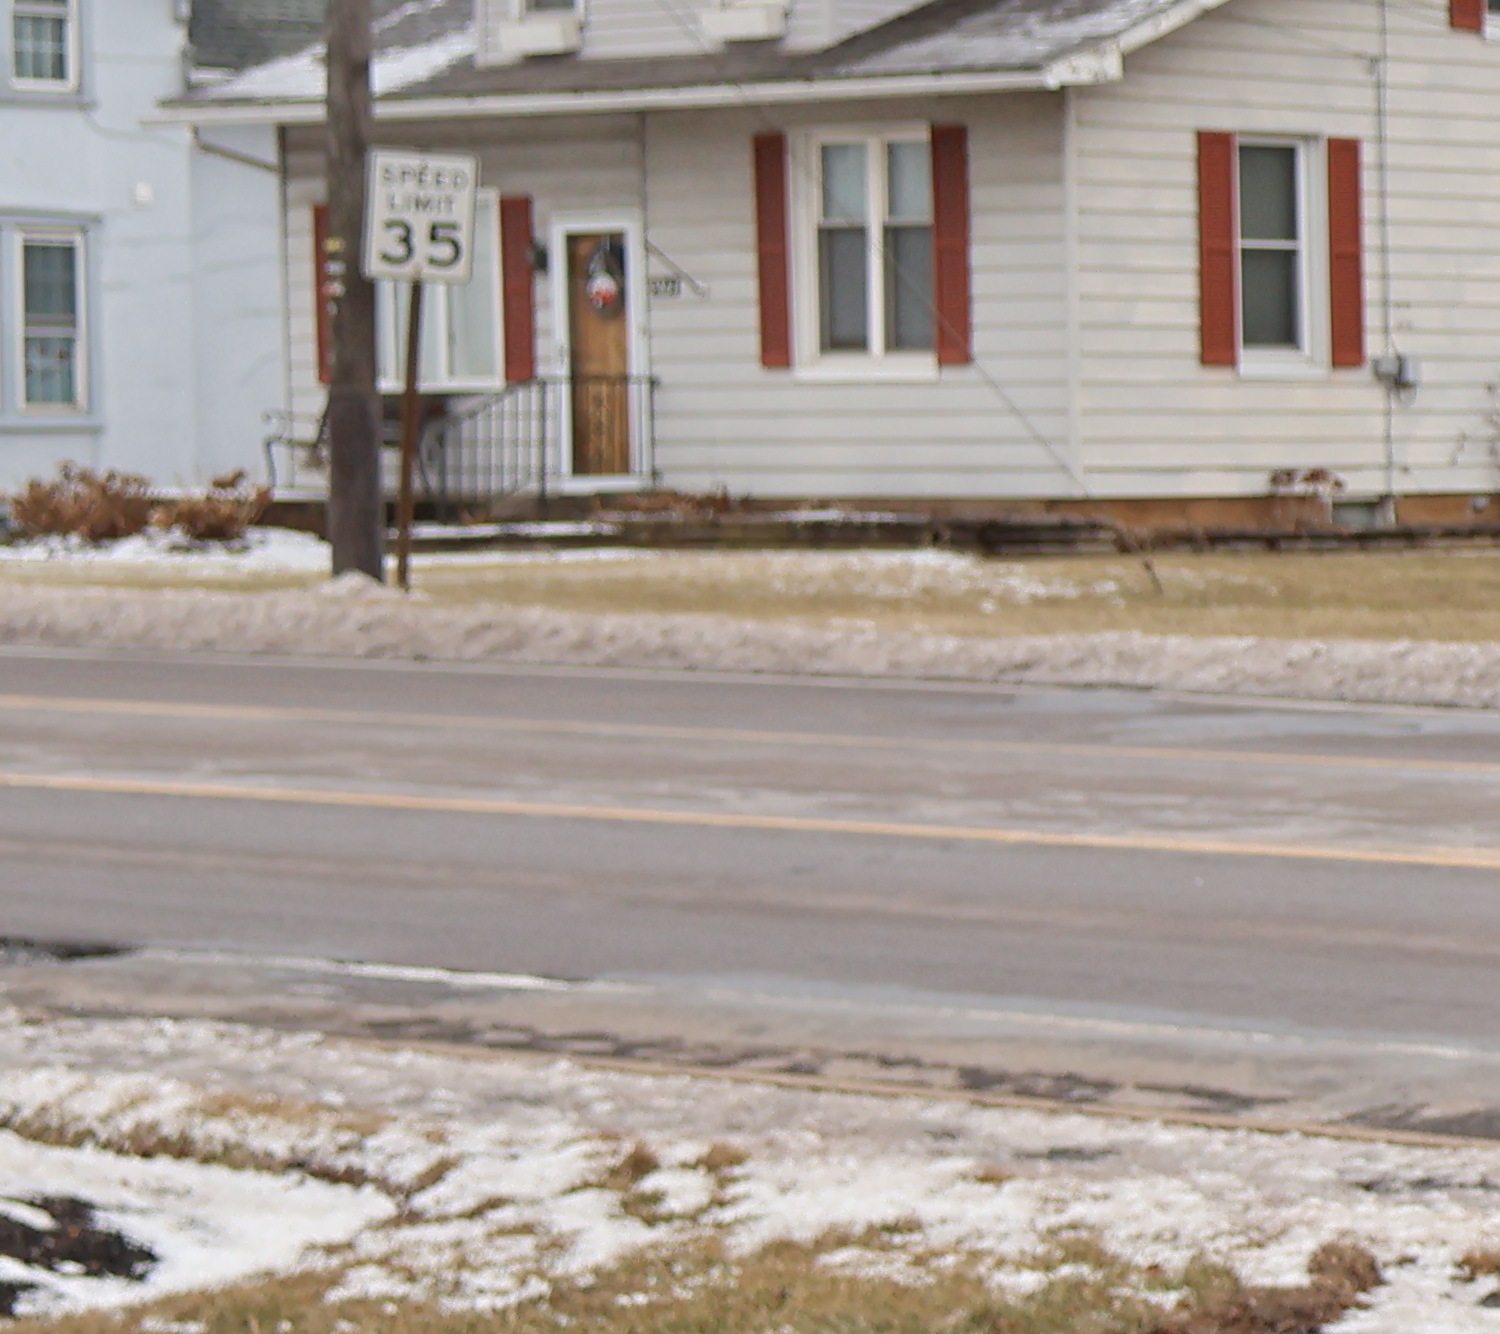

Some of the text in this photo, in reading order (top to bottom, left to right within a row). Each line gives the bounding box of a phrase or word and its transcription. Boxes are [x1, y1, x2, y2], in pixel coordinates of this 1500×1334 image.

[381, 165, 470, 192] SPEED
[386, 193, 456, 213] LIMIT
[379, 219, 462, 268] 35
